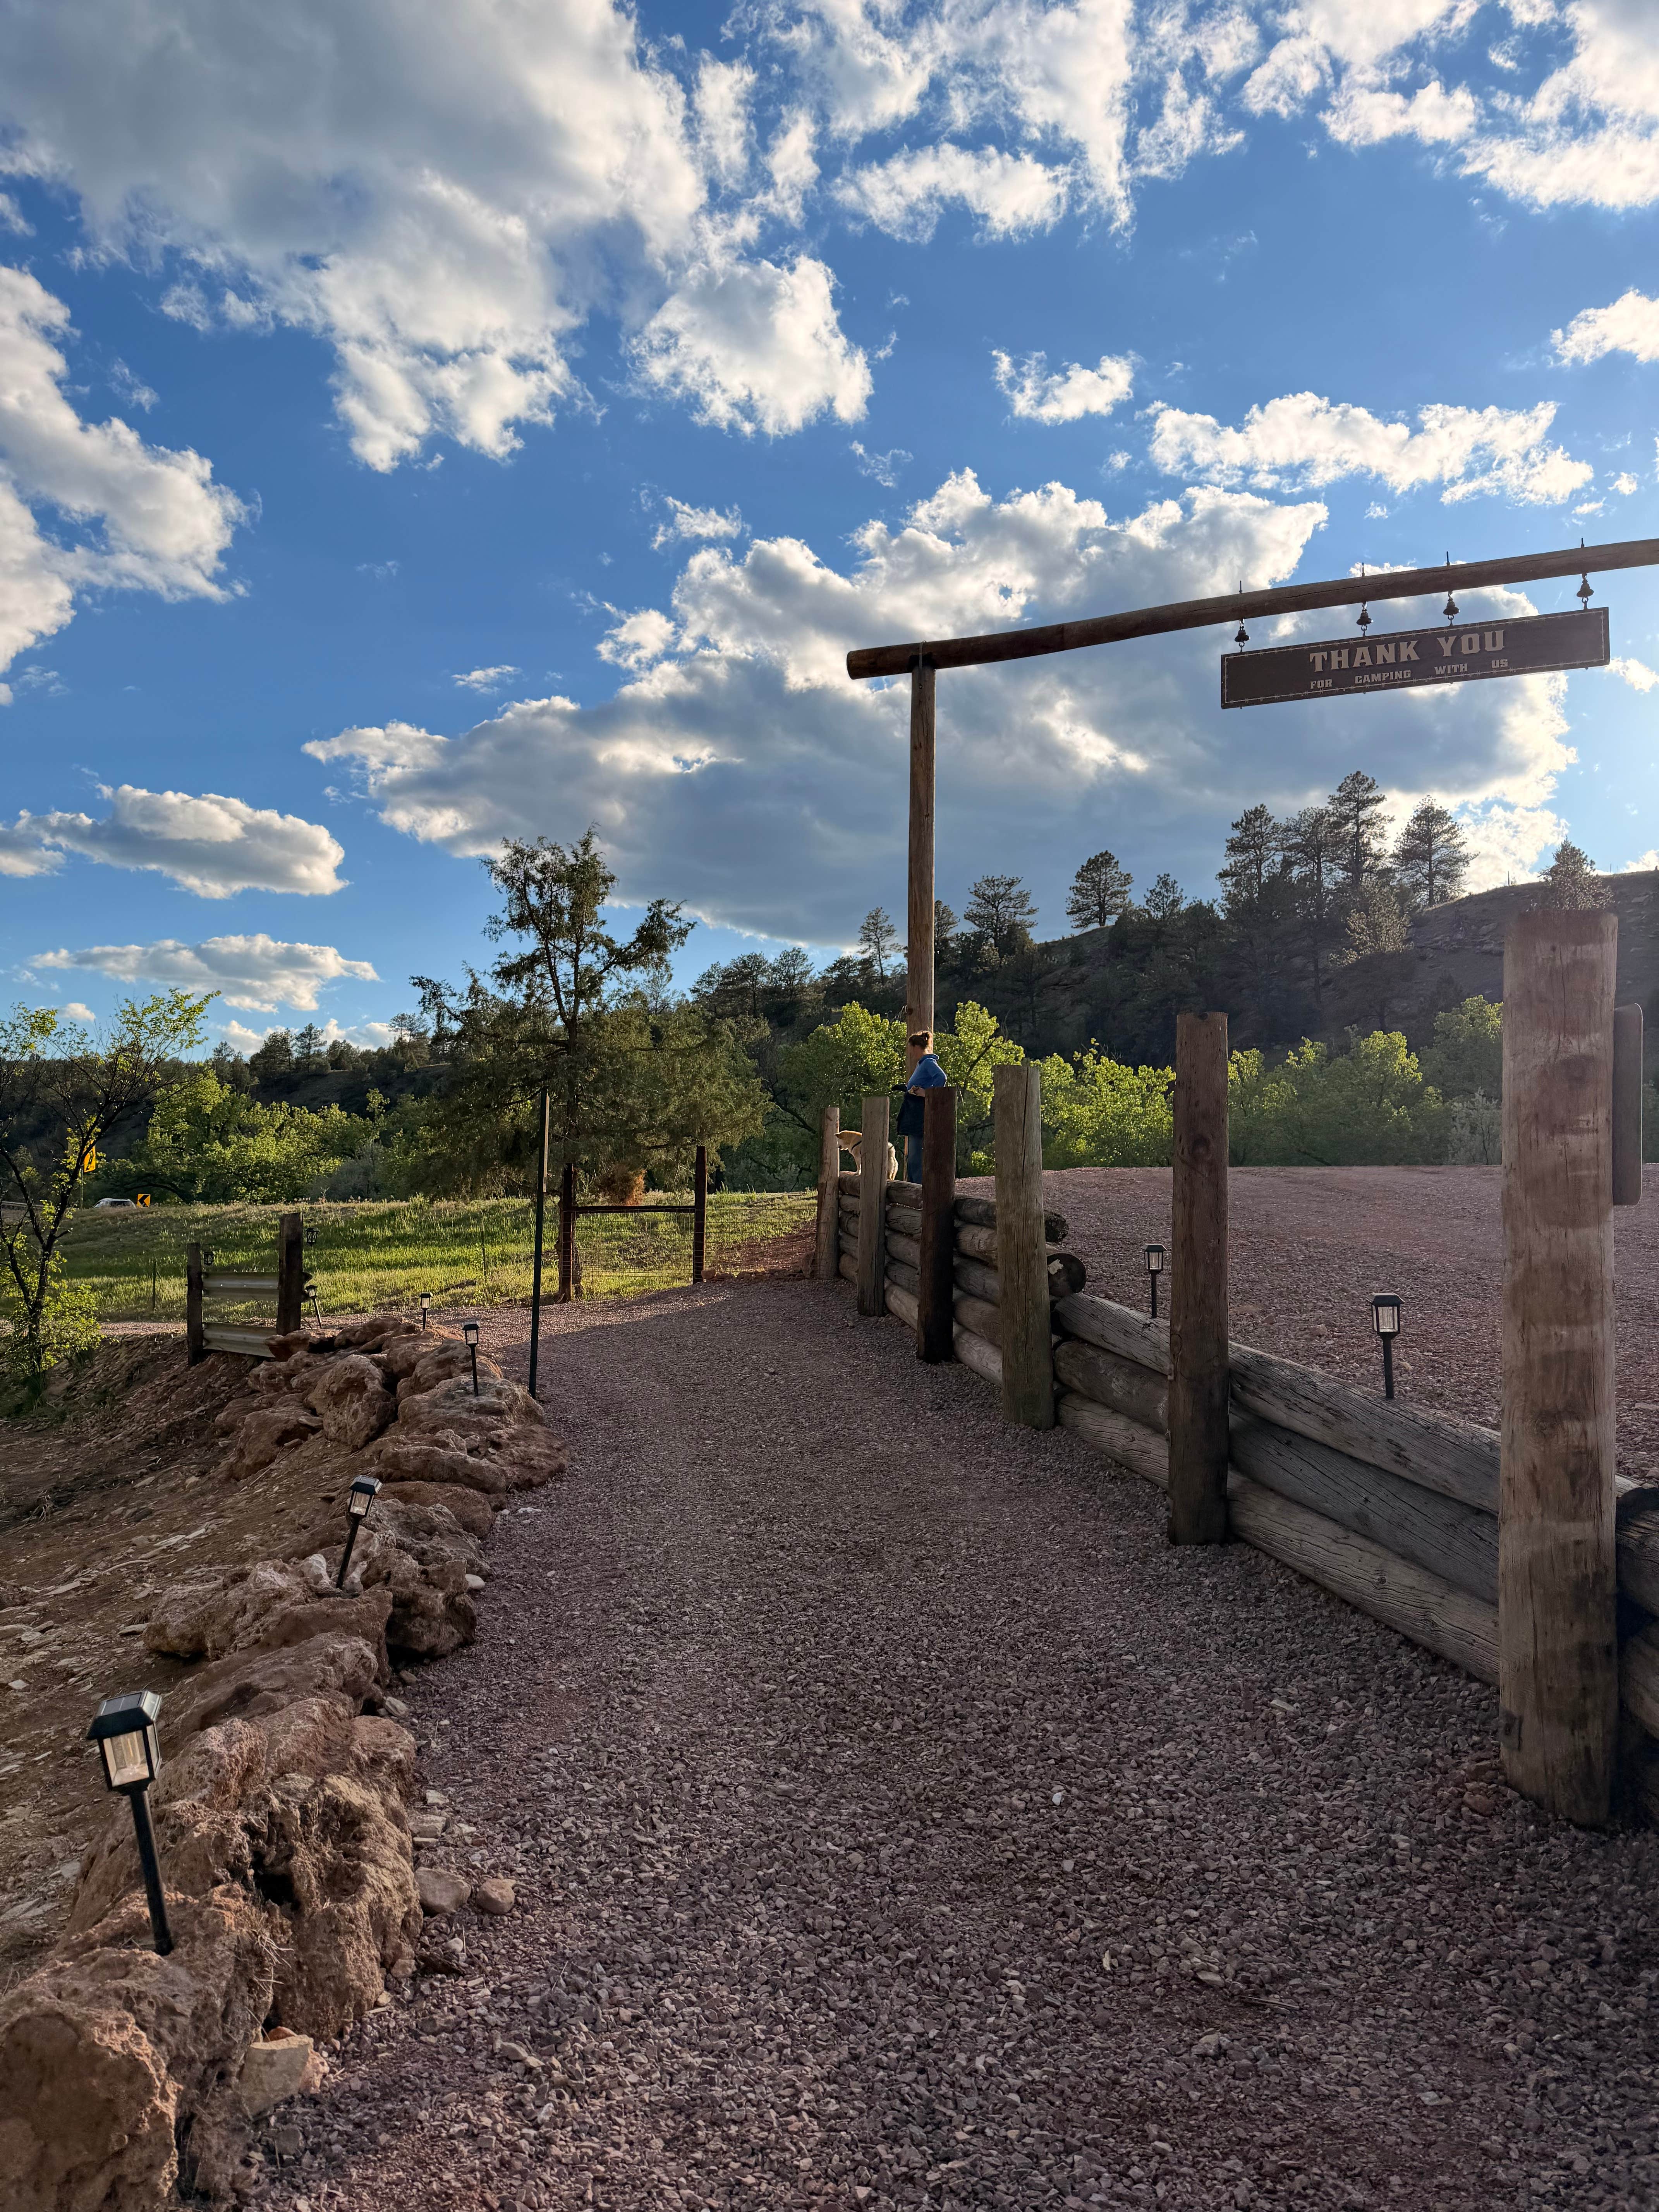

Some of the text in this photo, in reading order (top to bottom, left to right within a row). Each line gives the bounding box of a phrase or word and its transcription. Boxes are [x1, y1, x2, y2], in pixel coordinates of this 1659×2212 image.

[1310, 630, 1504, 672] THANK YOU
[1310, 659, 1508, 689] FOR CAMPING WITH US
